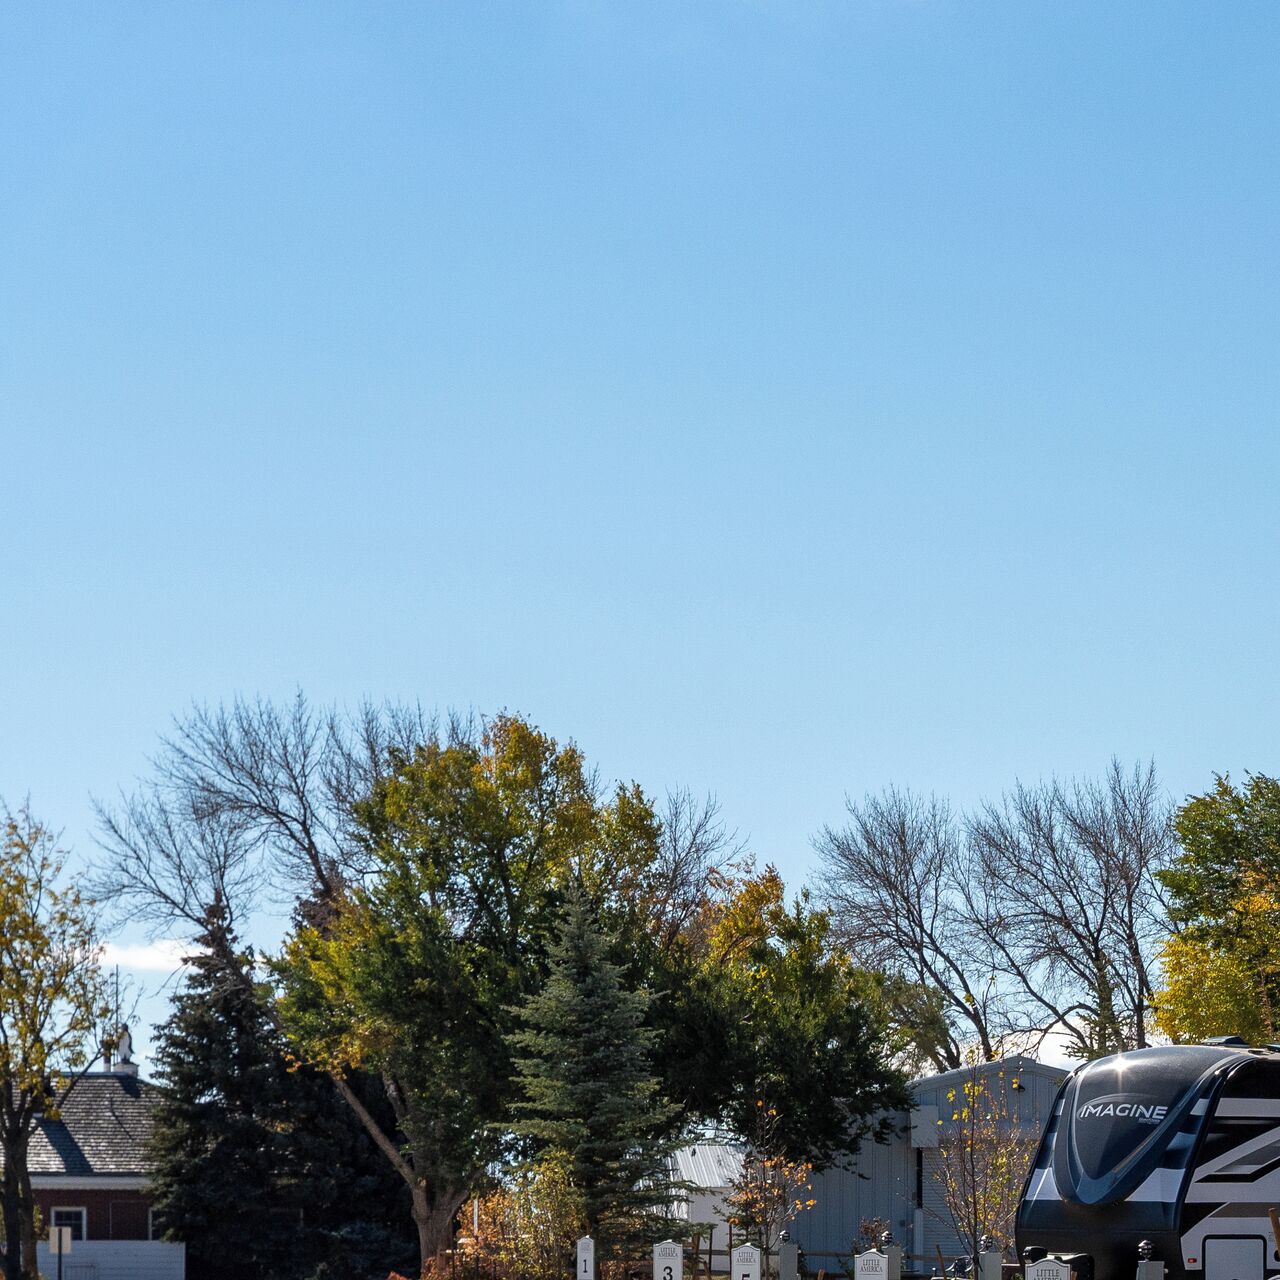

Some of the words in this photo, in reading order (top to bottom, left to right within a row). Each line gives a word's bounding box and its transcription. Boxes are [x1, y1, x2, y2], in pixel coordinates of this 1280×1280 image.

[1080, 1103, 1168, 1119] IMAGINE
[583, 1259, 588, 1273] 1
[1036, 1269, 1060, 1277] LITTLE
